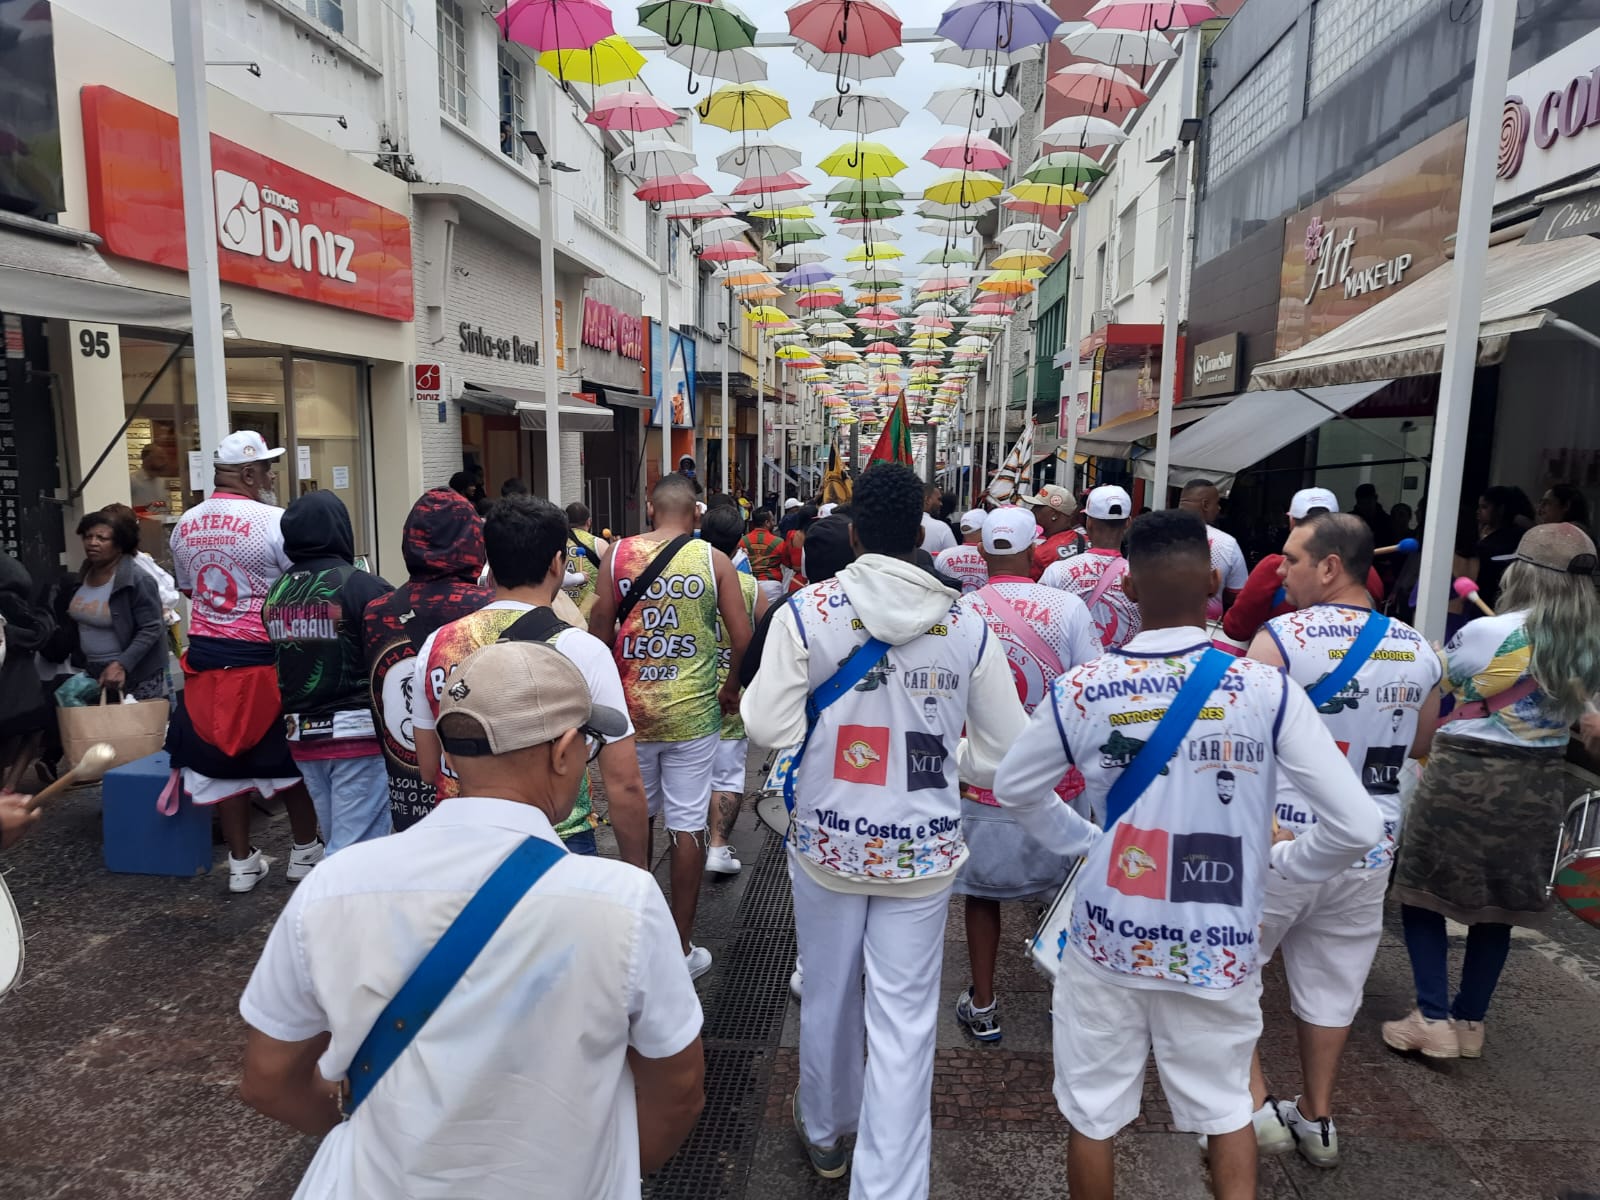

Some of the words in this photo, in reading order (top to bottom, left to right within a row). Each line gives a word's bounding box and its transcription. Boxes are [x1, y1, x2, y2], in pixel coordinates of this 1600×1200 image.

[262, 207, 357, 284] DINIZ
[1304, 227, 1356, 305] Art
[1344, 254, 1412, 300] MAKE-UP
[79, 329, 110, 359] 95
[416, 393, 440, 401] DINIZ
[180, 514, 251, 538] BATERIA
[618, 574, 705, 600] BOCO
[642, 604, 679, 630] DA
[622, 629, 697, 660] LEÕES
[639, 665, 678, 681] 2023
[904, 671, 959, 690] CARDOSO
[1189, 740, 1265, 762] CARDOSO
[815, 809, 850, 832] Vila
[855, 817, 911, 840] Costa
[916, 825, 926, 839] e
[1181, 861, 1234, 883] MD
[1085, 900, 1114, 933] Vila
[1119, 920, 1184, 942] Costa
[1190, 928, 1202, 944] e
